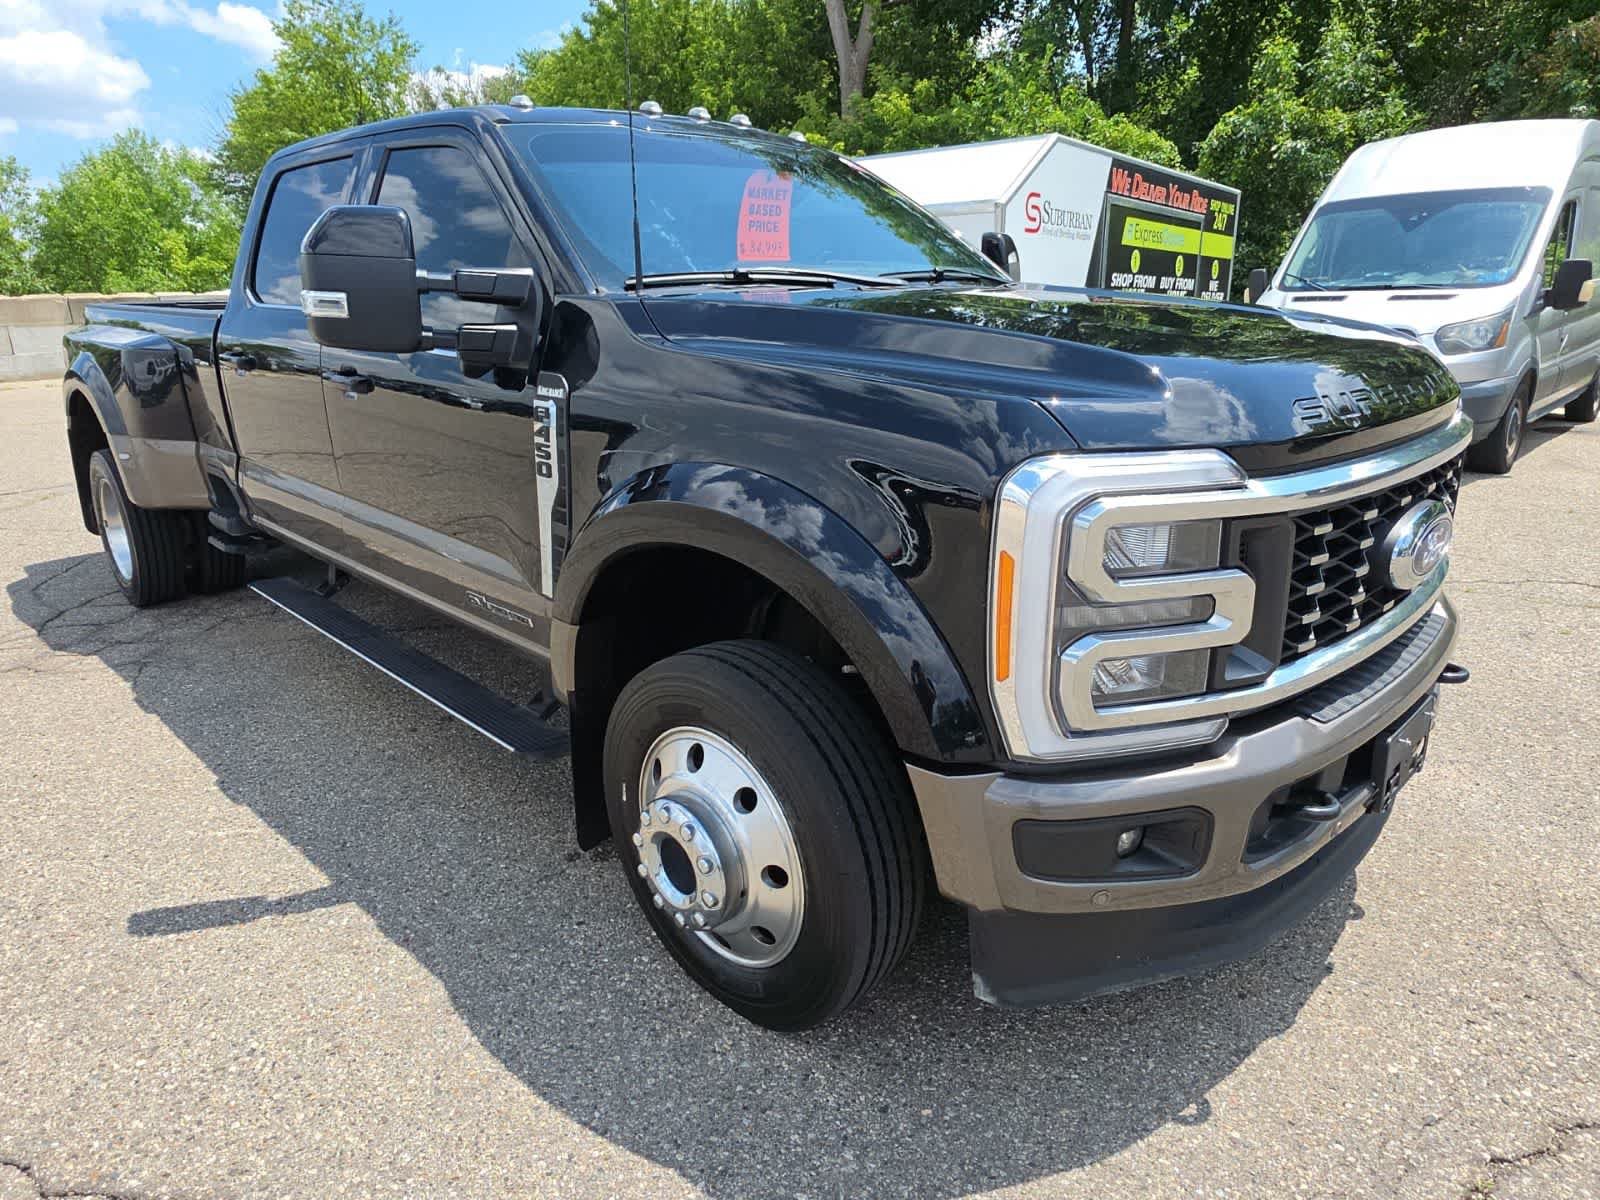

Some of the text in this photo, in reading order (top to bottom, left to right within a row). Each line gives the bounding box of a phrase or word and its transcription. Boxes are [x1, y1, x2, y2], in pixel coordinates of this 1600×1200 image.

[748, 186, 788, 200] MARKET
[748, 203, 782, 216] BASED
[1042, 200, 1093, 230] SUBURBAN
[748, 219, 780, 233] PRICE
[1110, 272, 1156, 289] SHOP FROM
[1160, 277, 1195, 291] BUY FROM
[1209, 280, 1219, 292] WE
